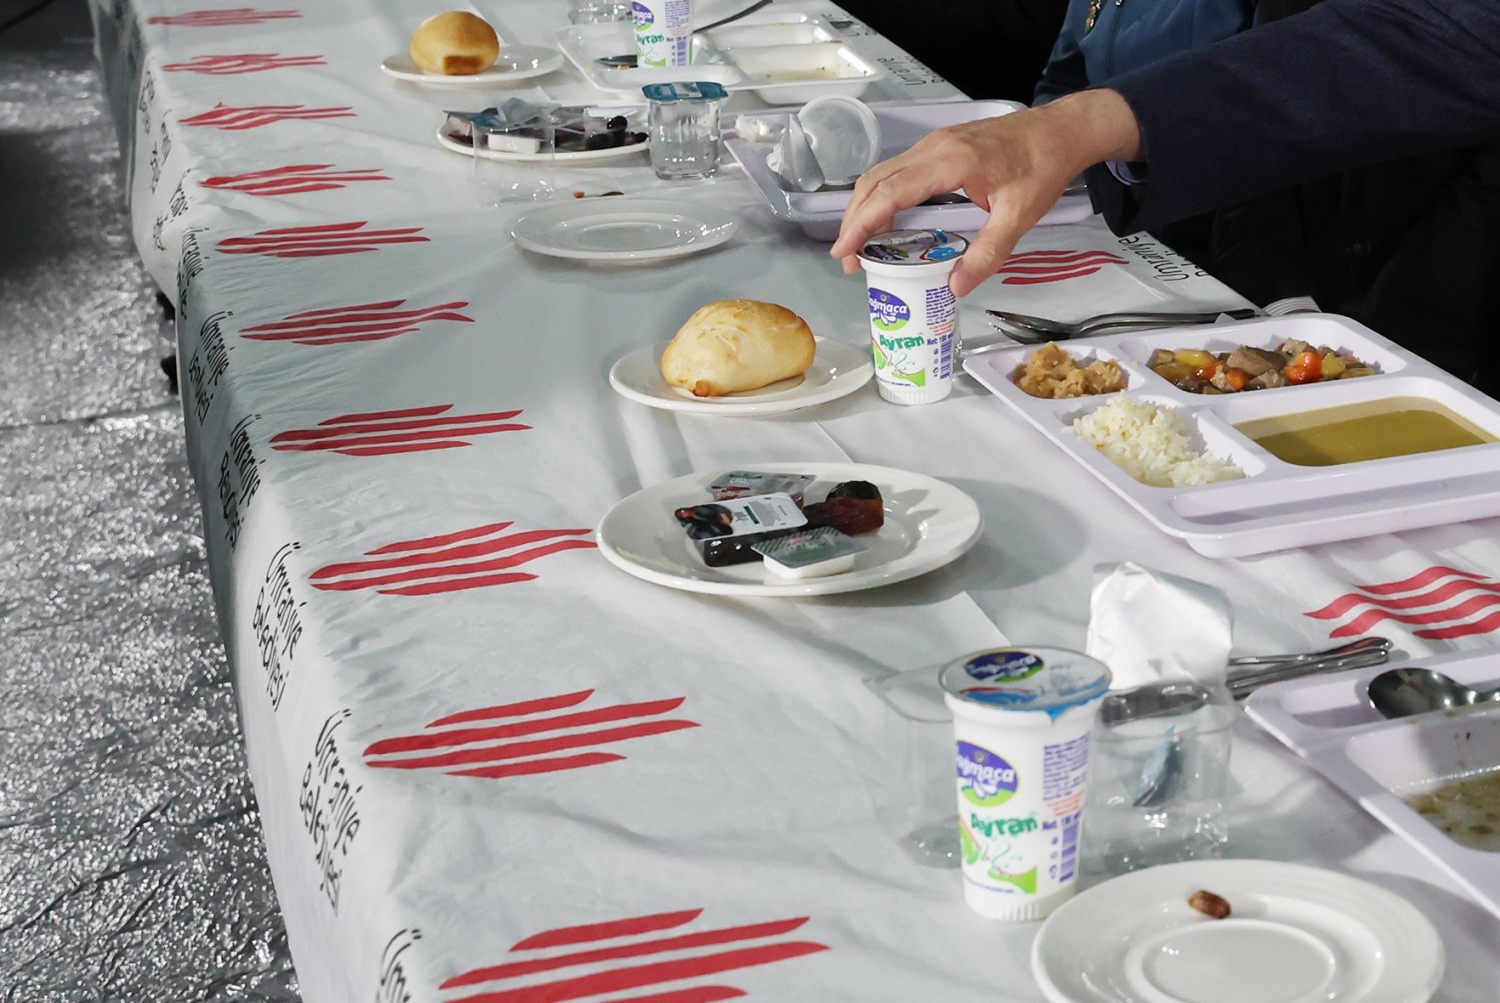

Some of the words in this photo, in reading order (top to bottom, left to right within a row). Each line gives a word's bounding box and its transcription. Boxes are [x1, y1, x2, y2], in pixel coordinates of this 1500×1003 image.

[200, 311, 235, 386] Ümraniye
[879, 335, 925, 351] Ayran
[231, 414, 266, 507] Ümraniye
[266, 542, 307, 660] Ümraniye
[316, 709, 363, 856] Ümraniye
[971, 813, 1038, 837] Ayran
